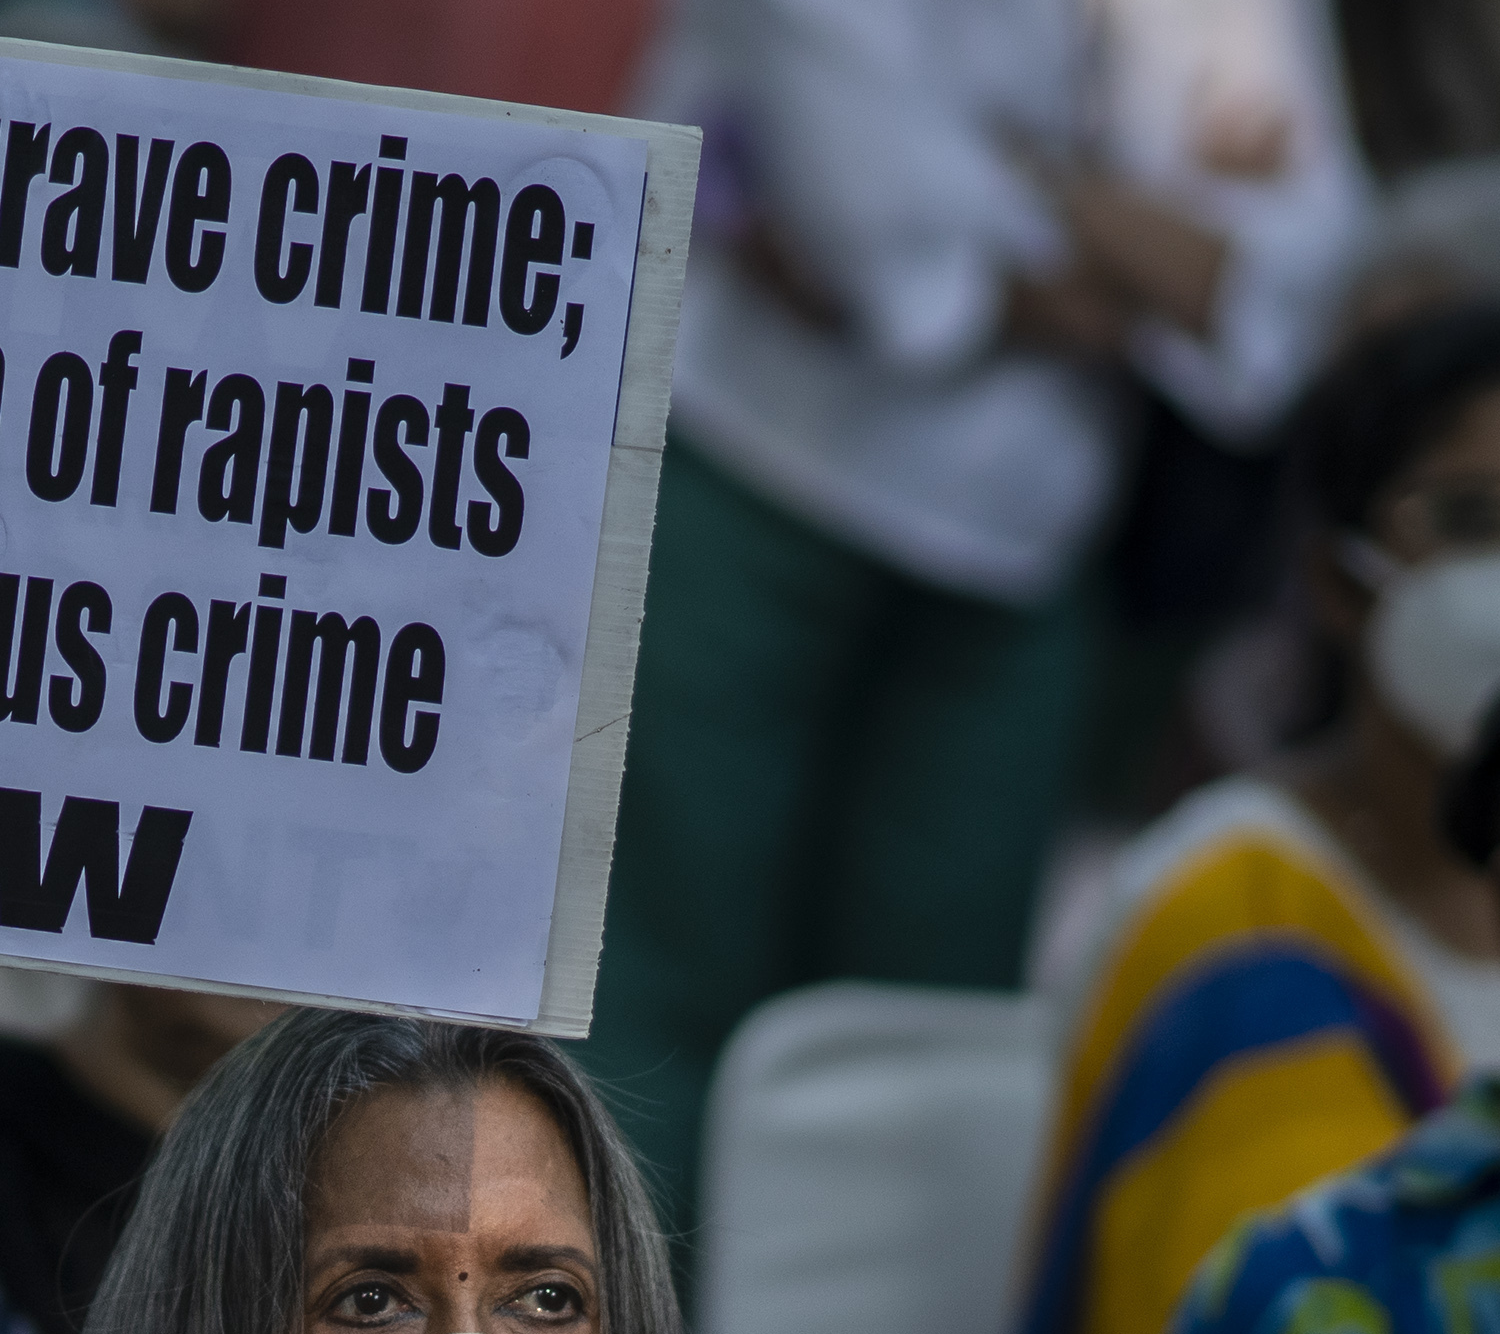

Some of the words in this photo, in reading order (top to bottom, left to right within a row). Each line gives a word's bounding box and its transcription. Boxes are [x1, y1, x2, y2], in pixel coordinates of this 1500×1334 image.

[254, 135, 596, 360] crime;
[26, 330, 143, 507] of
[150, 358, 530, 557] rapists
[134, 573, 445, 774] crime
